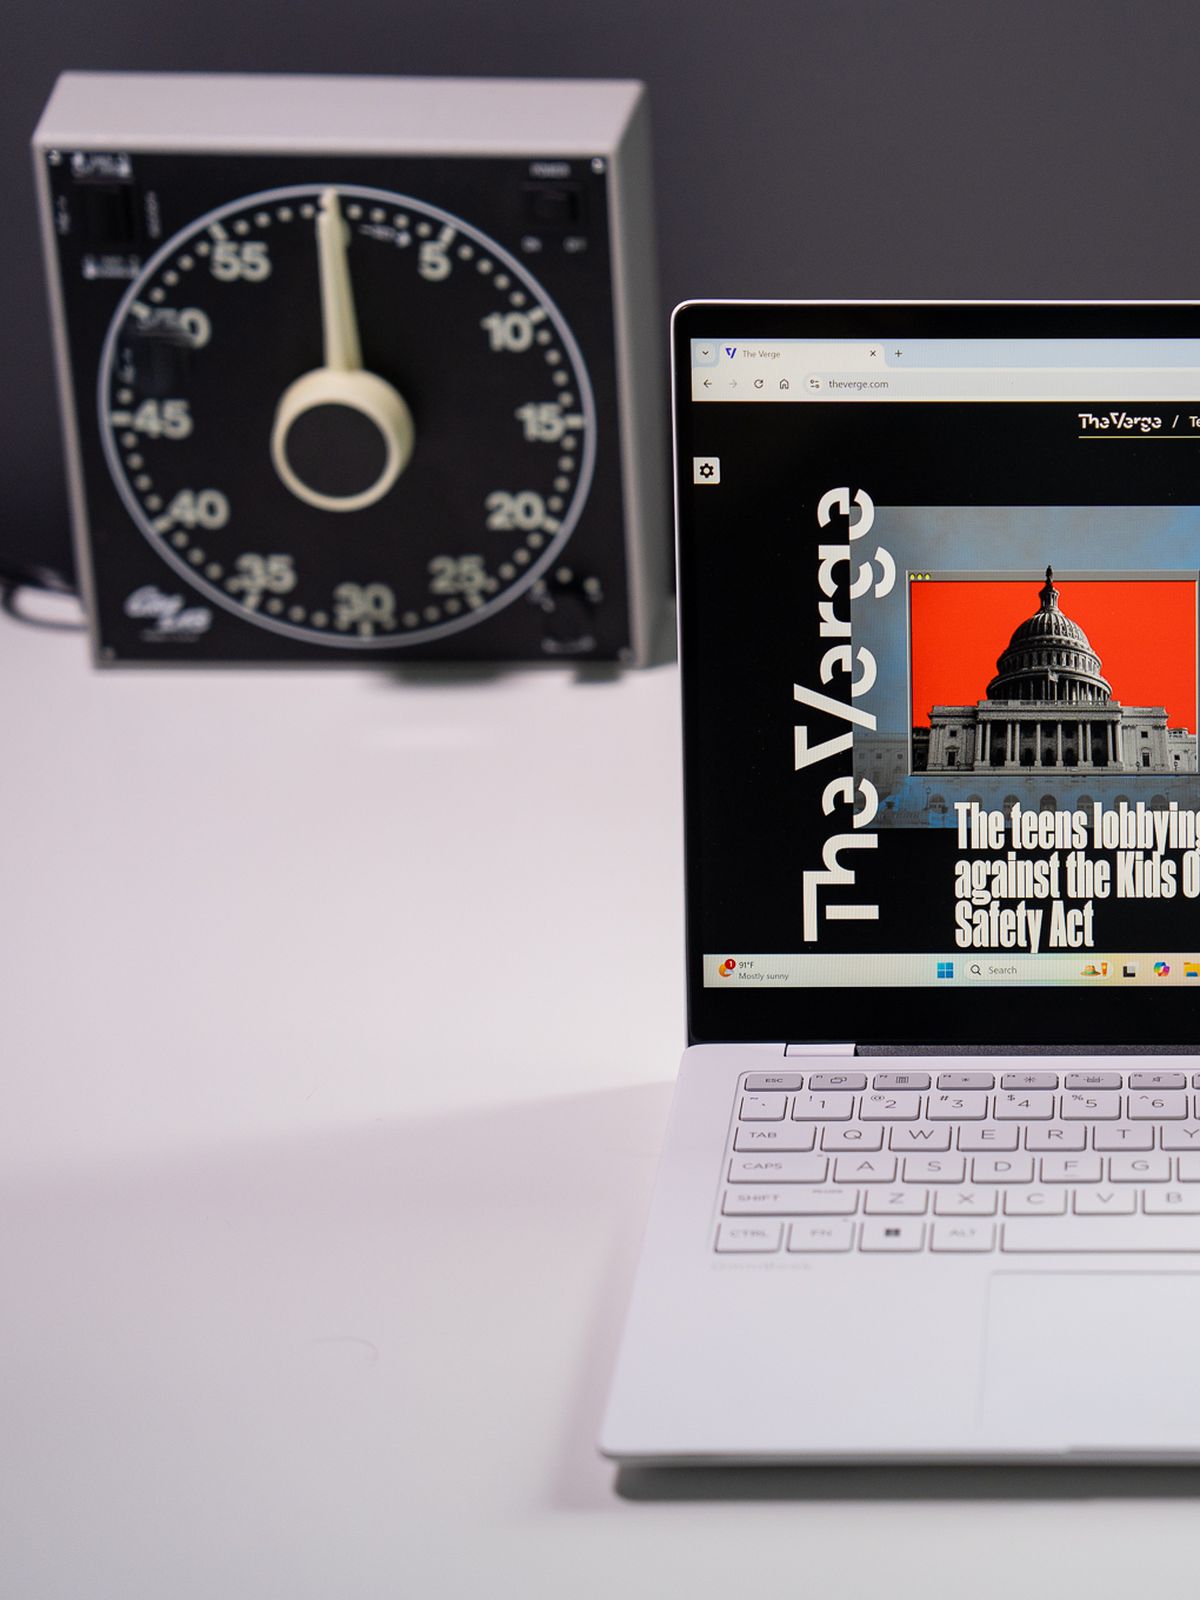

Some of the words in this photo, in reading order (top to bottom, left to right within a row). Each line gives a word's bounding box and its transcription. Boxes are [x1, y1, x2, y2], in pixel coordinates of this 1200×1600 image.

[211, 241, 271, 281] 55
[418, 241, 452, 281] 5
[482, 314, 534, 351] 10
[742, 350, 757, 358] The
[758, 350, 781, 360] Verge
[828, 379, 889, 391] theverge.com
[133, 401, 192, 439] 45
[517, 404, 565, 440] 15
[167, 490, 229, 529] 40
[487, 492, 546, 530] 20
[236, 556, 295, 593] 35
[430, 557, 485, 593] 25
[335, 587, 395, 625] 30
[954, 802, 1005, 849] The
[1011, 802, 1088, 849] teens
[955, 852, 1060, 905] against
[1066, 852, 1110, 898] the
[1117, 851, 1177, 898] Kids
[955, 900, 1043, 953] Safety
[1049, 900, 1094, 947] Act
[988, 966, 1018, 975] Search
[738, 972, 765, 982] Mostly
[766, 974, 789, 982] sunny
[818, 1099, 826, 1110] 1
[883, 1097, 897, 1109] 2
[951, 1099, 964, 1108] 3
[1017, 1099, 1030, 1108] 4
[1086, 1099, 1098, 1108] 5
[1151, 1099, 1165, 1108] 6
[749, 1131, 777, 1139] TAB
[842, 1129, 863, 1140] Q
[908, 1129, 934, 1140] W
[981, 1129, 994, 1140] E
[1047, 1129, 1064, 1140] R
[1117, 1129, 1130, 1139] T
[1183, 1128, 1200, 1139] Y
[856, 1160, 875, 1171] A
[927, 1161, 942, 1172] S
